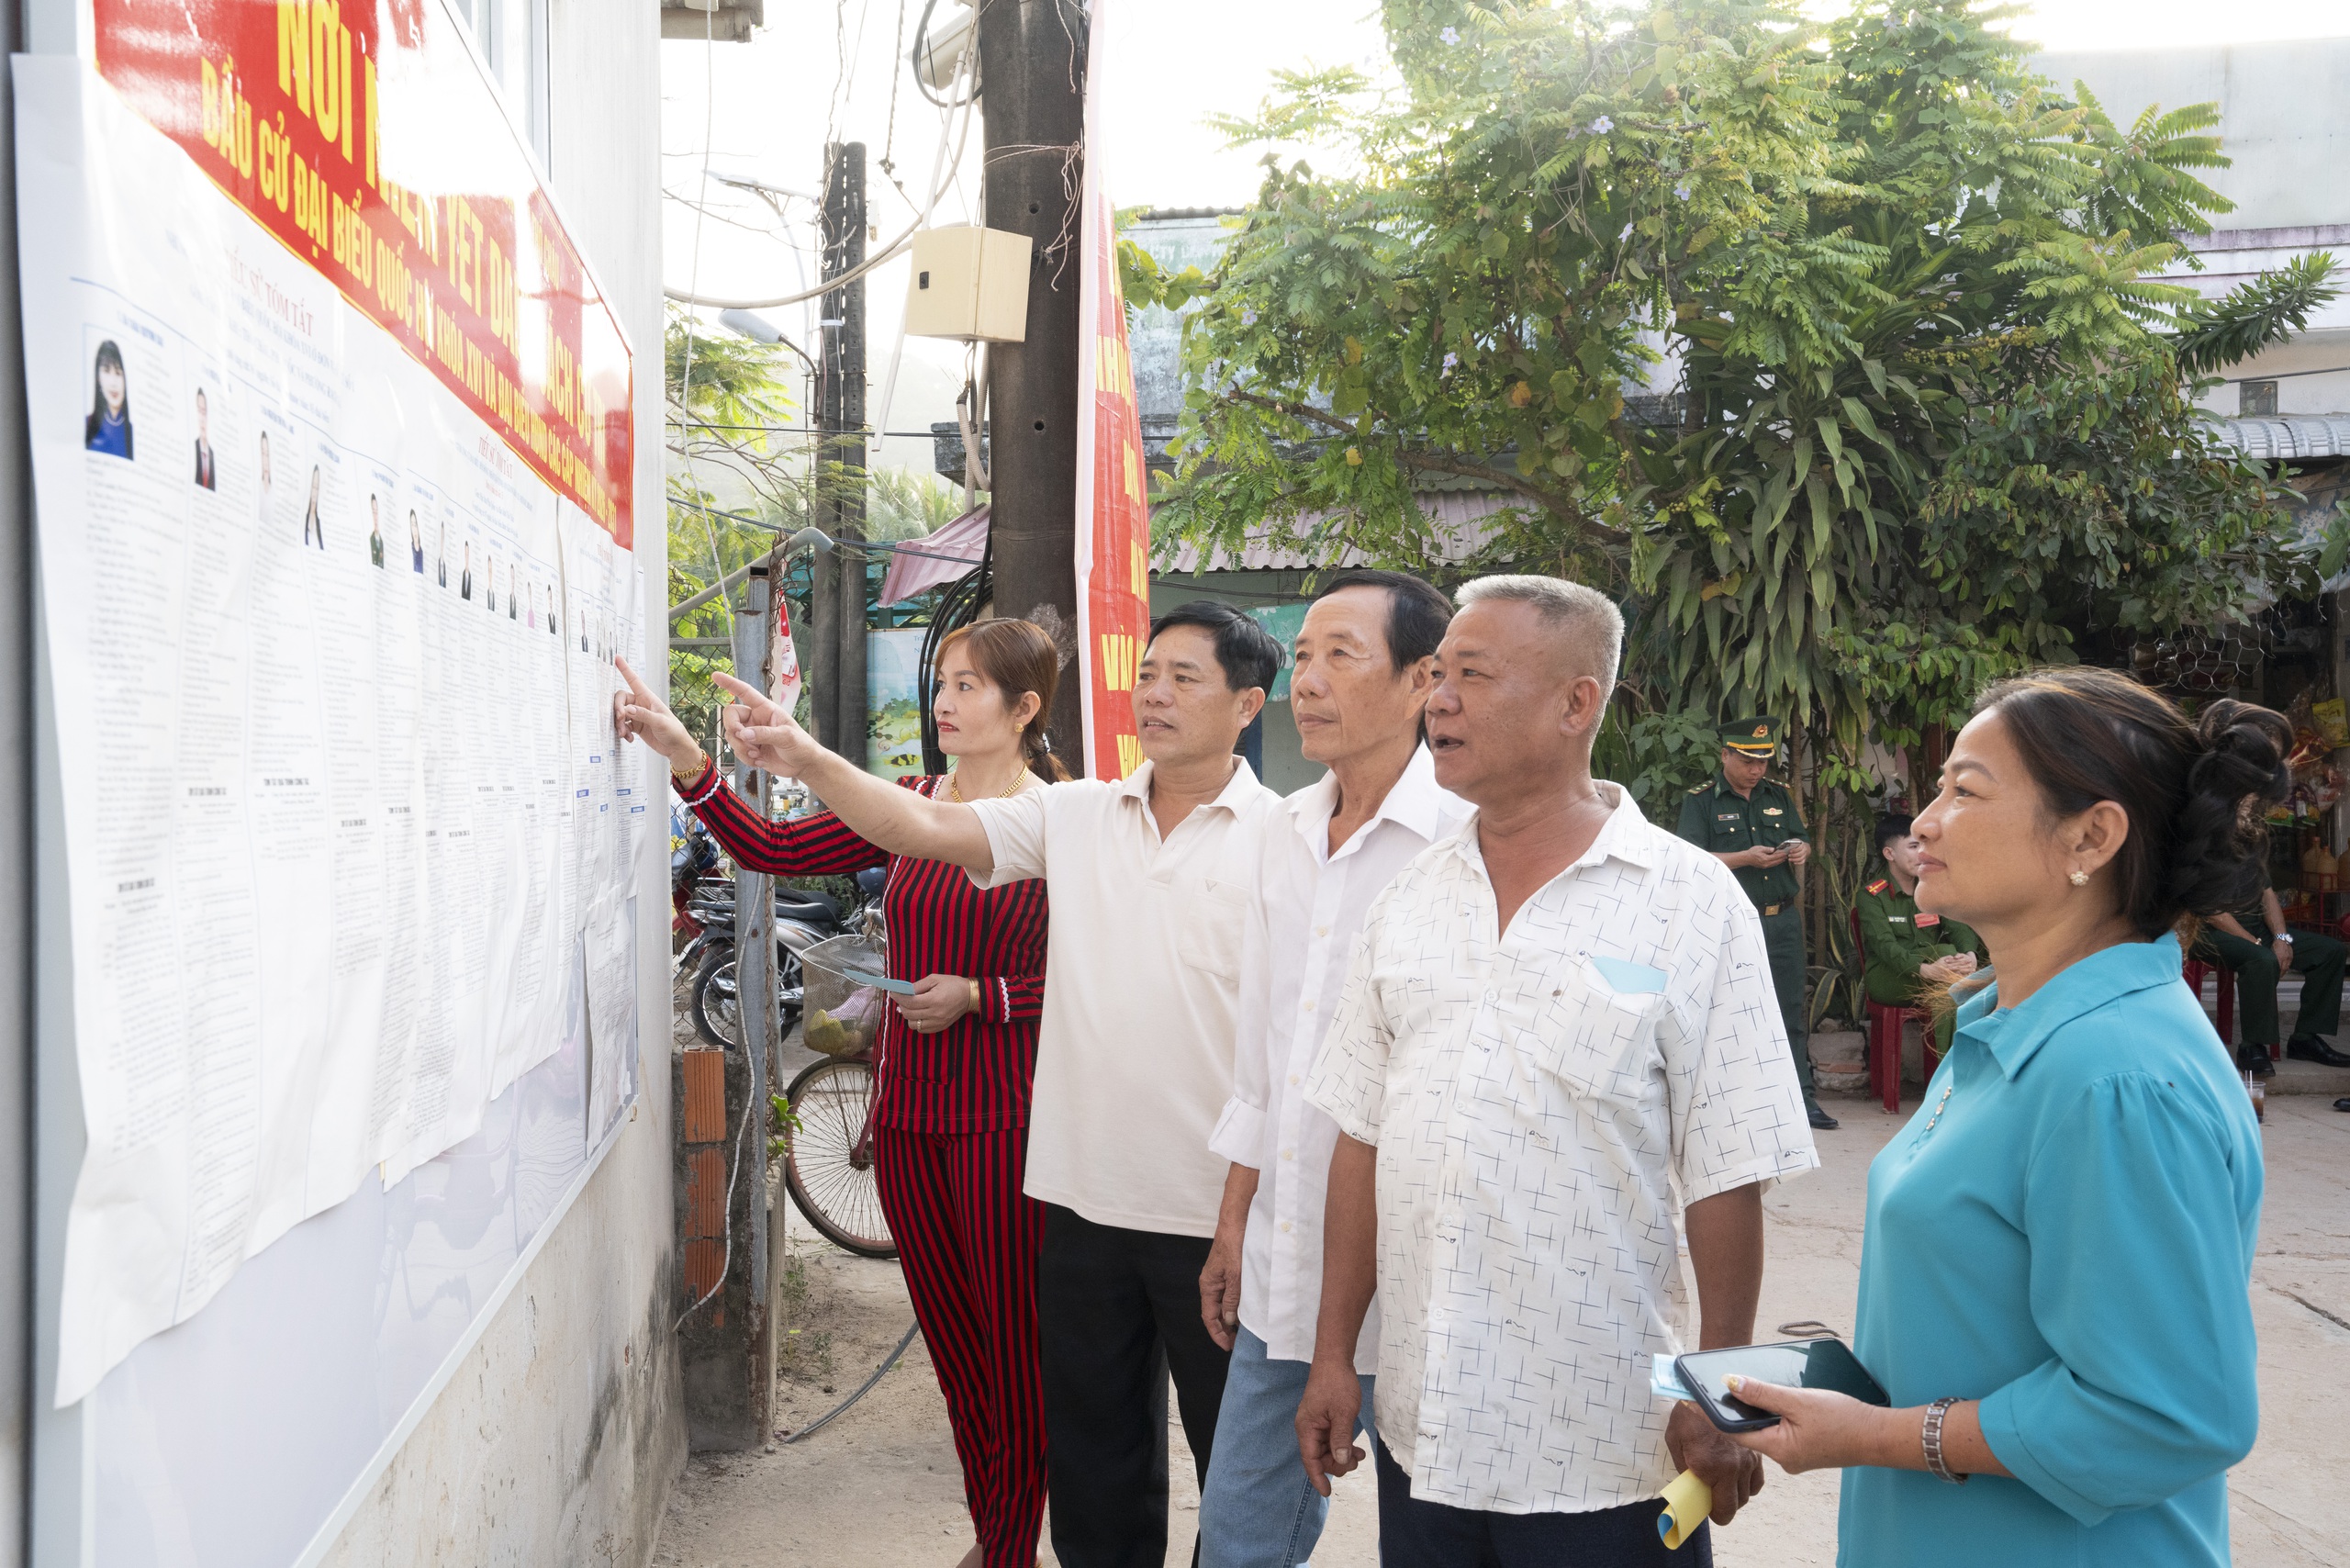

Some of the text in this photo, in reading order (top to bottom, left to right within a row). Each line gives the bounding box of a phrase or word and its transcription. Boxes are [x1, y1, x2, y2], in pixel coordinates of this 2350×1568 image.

[276, 0, 352, 165] NƠI
[201, 53, 253, 180] BẦU
[258, 109, 291, 213] CỬ
[293, 151, 328, 260] ĐẠI
[332, 188, 373, 290] BIỂU
[375, 240, 413, 330] QUỐC
[436, 303, 464, 384] KHÓA
[465, 337, 483, 400] XVI
[484, 352, 498, 414] VÀ
[498, 370, 513, 436] ĐẠI
[548, 424, 562, 478] CÁC
[561, 434, 575, 488] CẤP
